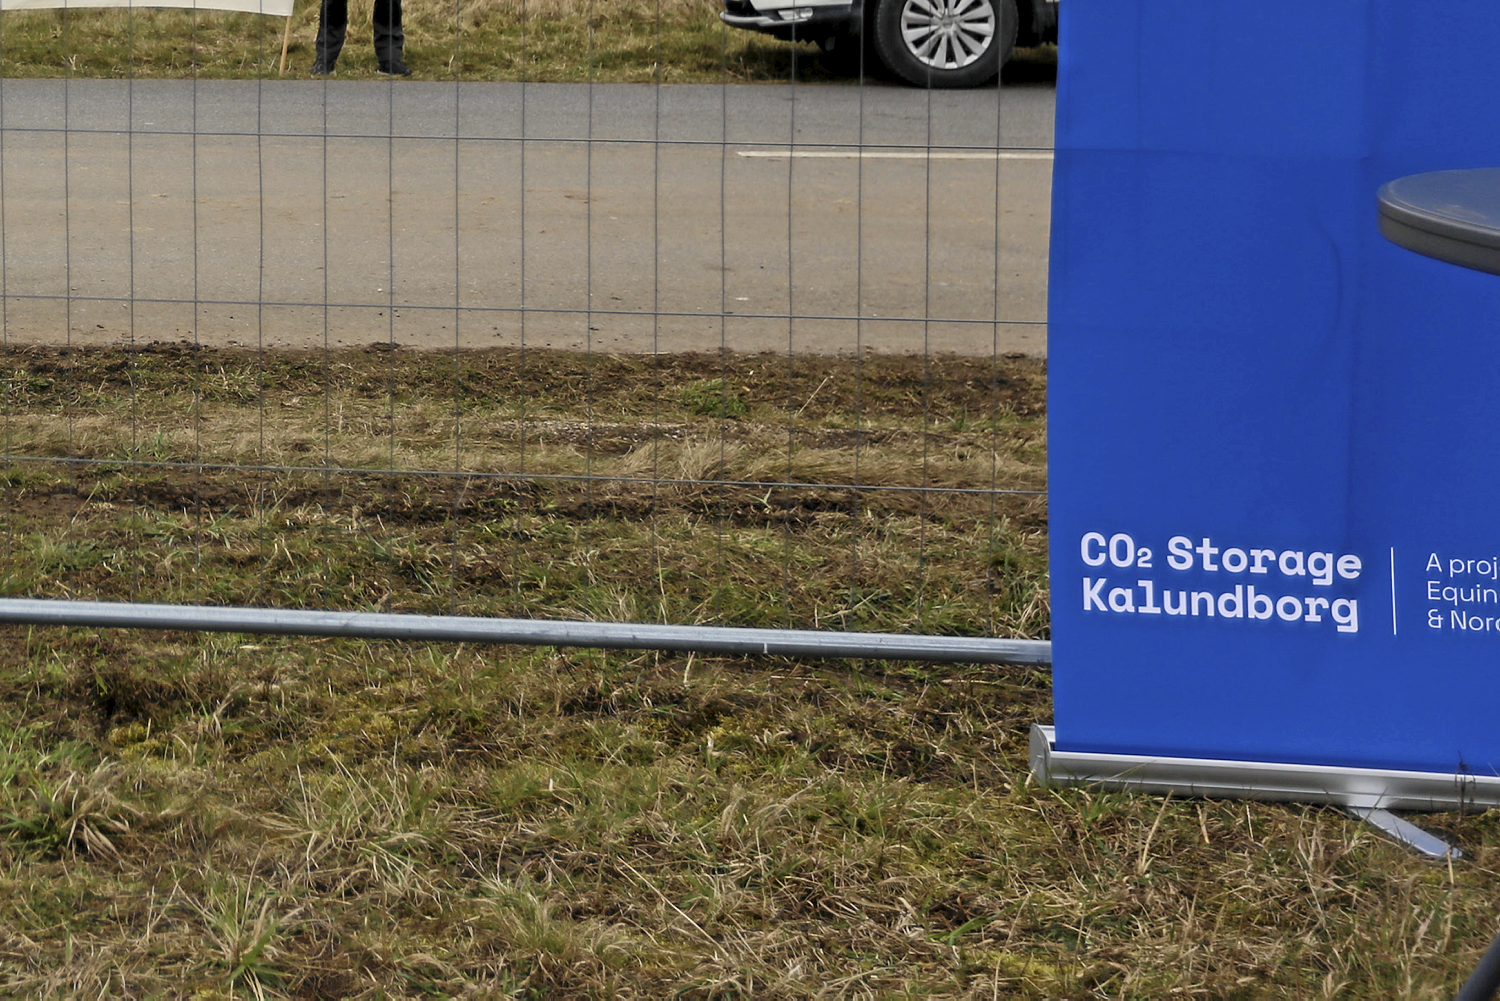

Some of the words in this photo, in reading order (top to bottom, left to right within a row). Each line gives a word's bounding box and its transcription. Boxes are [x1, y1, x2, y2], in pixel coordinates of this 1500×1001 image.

[1080, 531, 1153, 568] CO2
[1166, 535, 1362, 586] Storage
[1426, 552, 1442, 572] A
[1449, 556, 1500, 579] proj
[1082, 577, 1359, 633] Kalundborg
[1427, 580, 1500, 606] Equin
[1427, 608, 1444, 628] &
